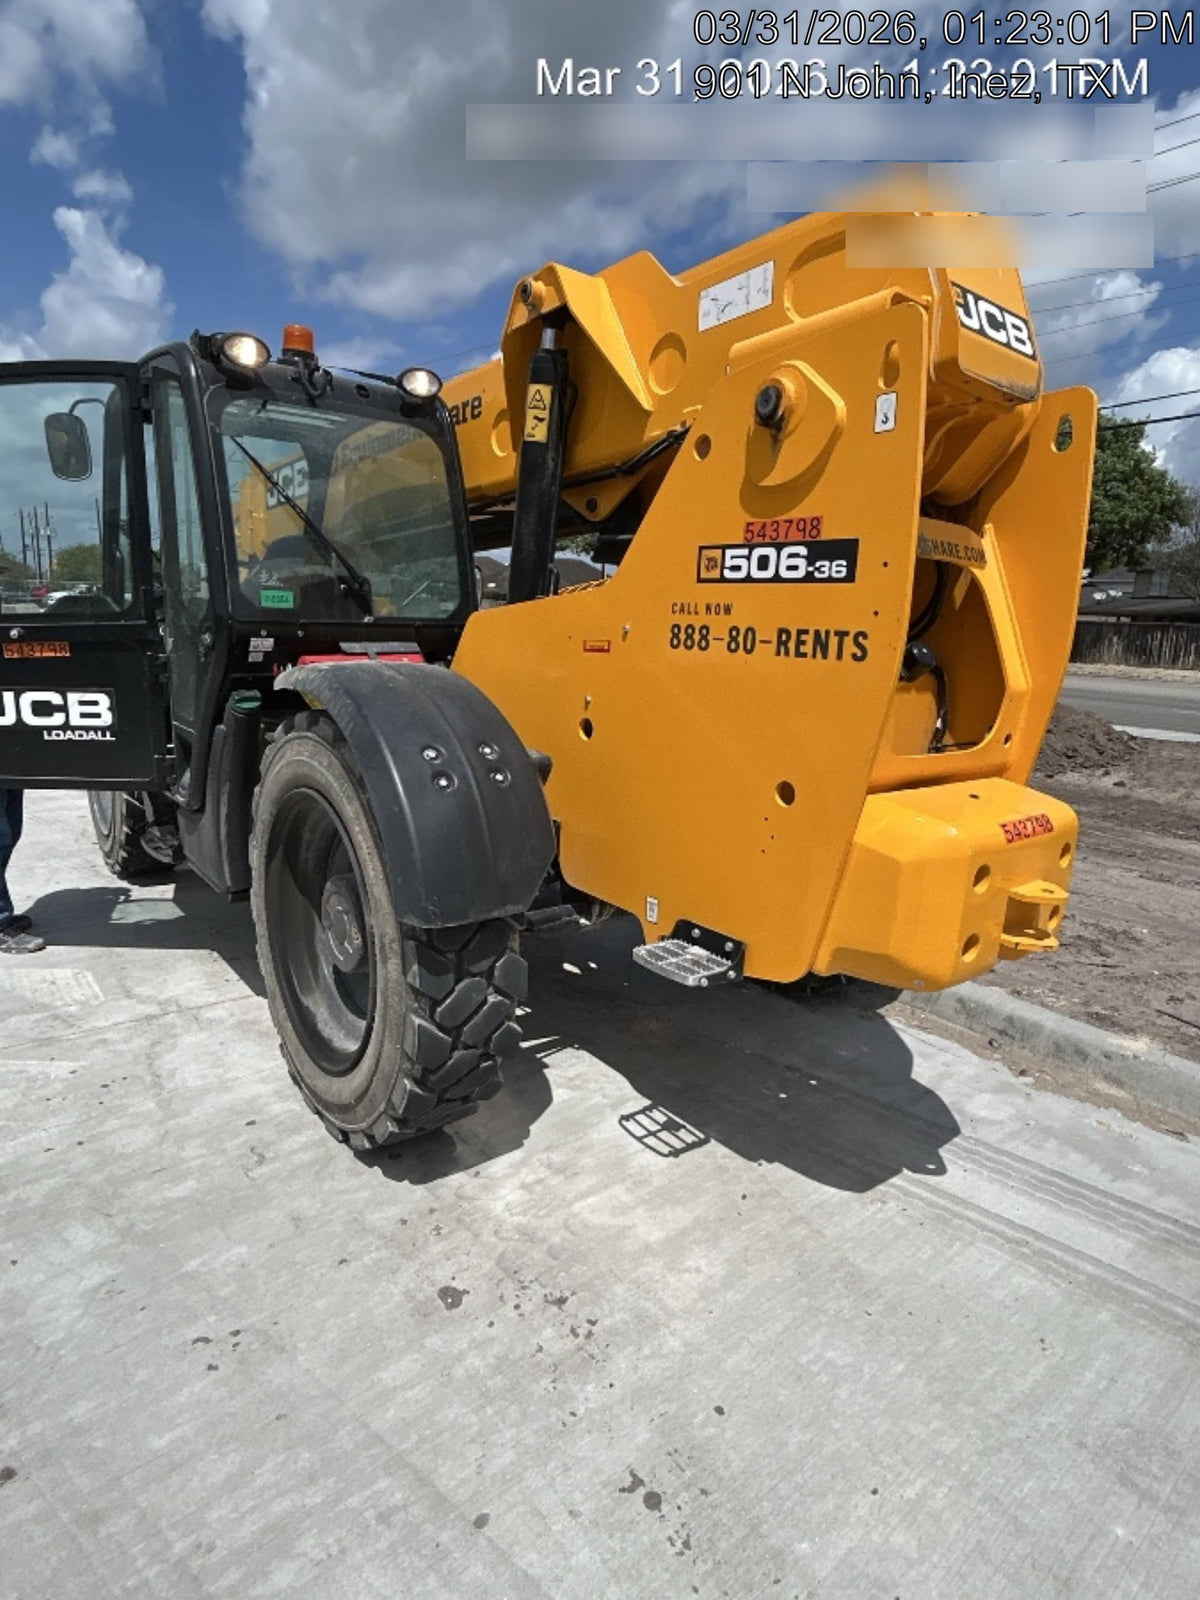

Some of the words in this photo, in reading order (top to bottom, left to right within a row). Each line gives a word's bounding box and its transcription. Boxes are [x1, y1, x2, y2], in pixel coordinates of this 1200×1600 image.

[956, 292, 1034, 357] JCB
[743, 516, 821, 543] 543798
[722, 545, 848, 579] 506-36
[671, 602, 699, 615] CALL
[705, 603, 734, 616] NOW
[4, 642, 69, 657] 543798
[669, 623, 869, 662] 888-80-RENTS
[0, 690, 113, 726] JCB
[43, 730, 116, 741] LOADALL
